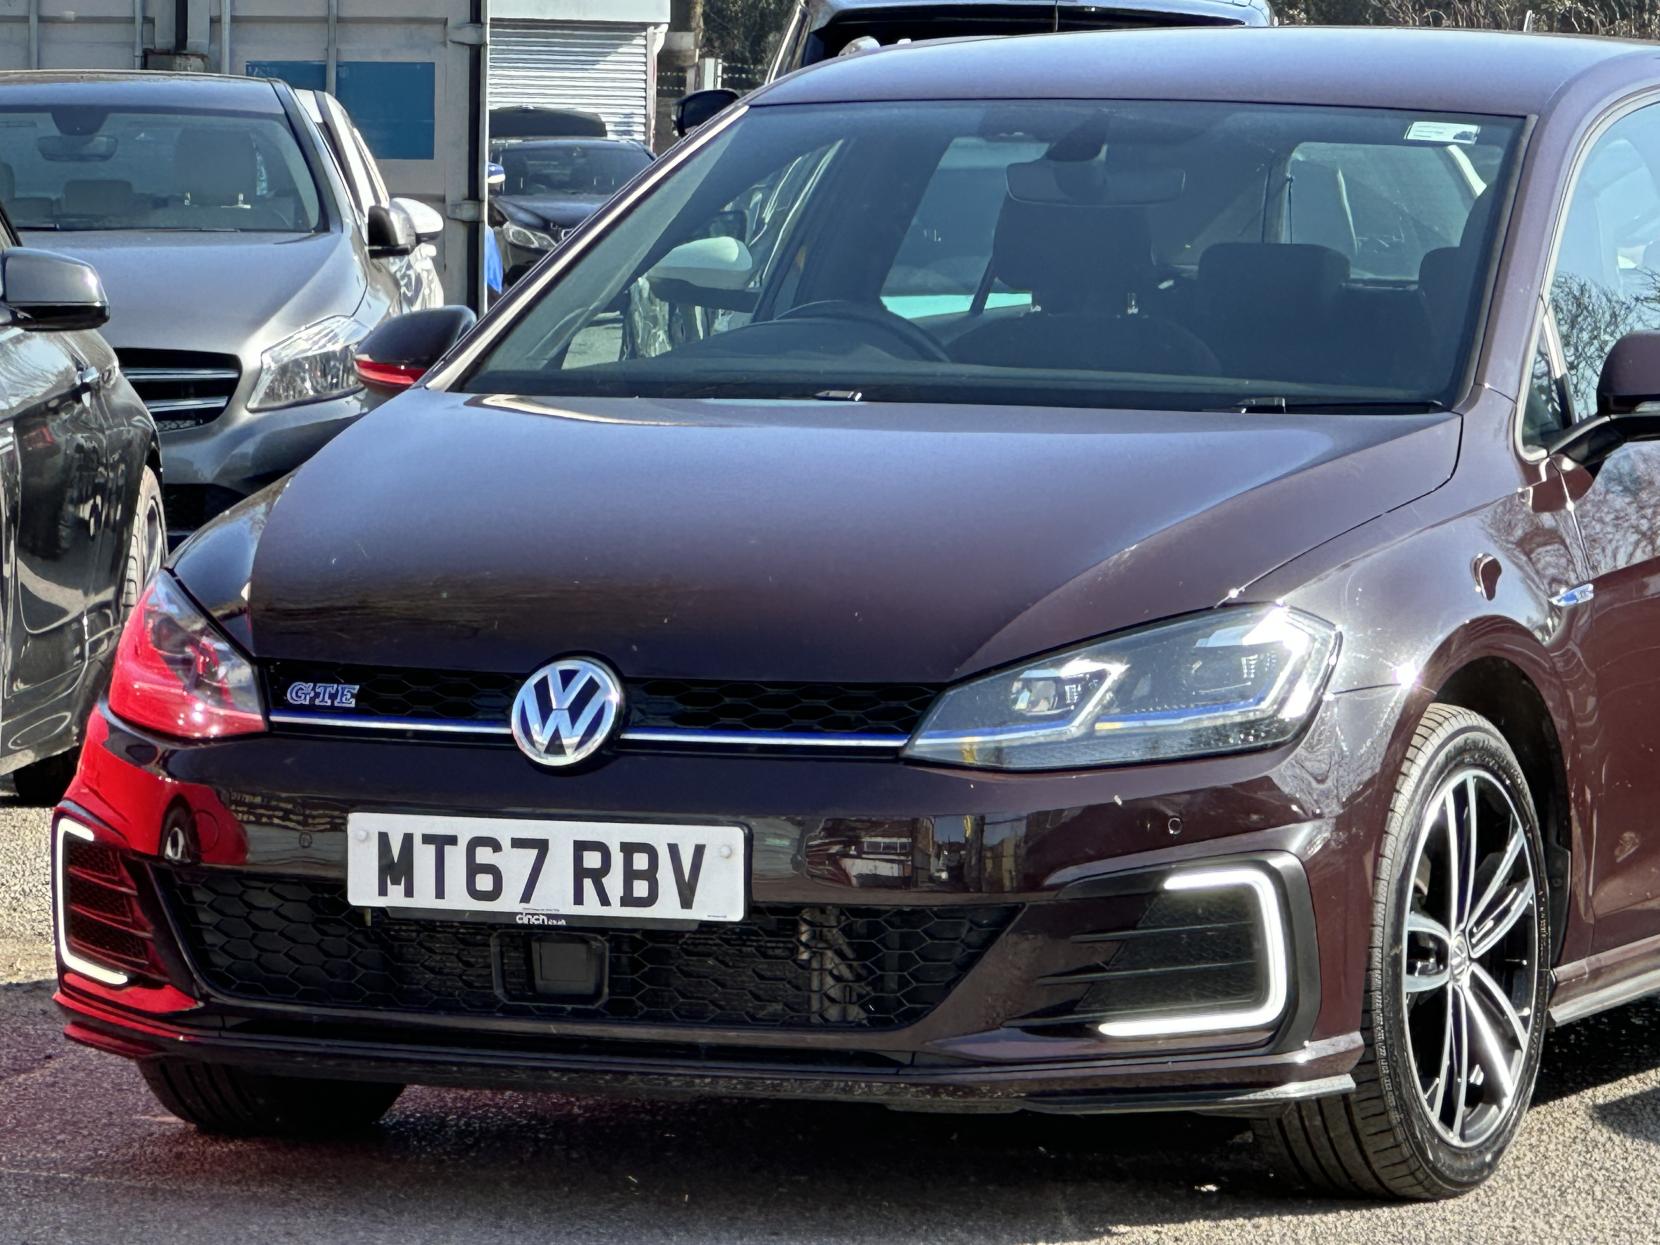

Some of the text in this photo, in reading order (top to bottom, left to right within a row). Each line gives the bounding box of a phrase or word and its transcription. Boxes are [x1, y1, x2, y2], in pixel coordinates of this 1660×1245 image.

[286, 681, 360, 708] GTE
[513, 659, 620, 763] VW
[377, 831, 706, 910] MT67 RBV
